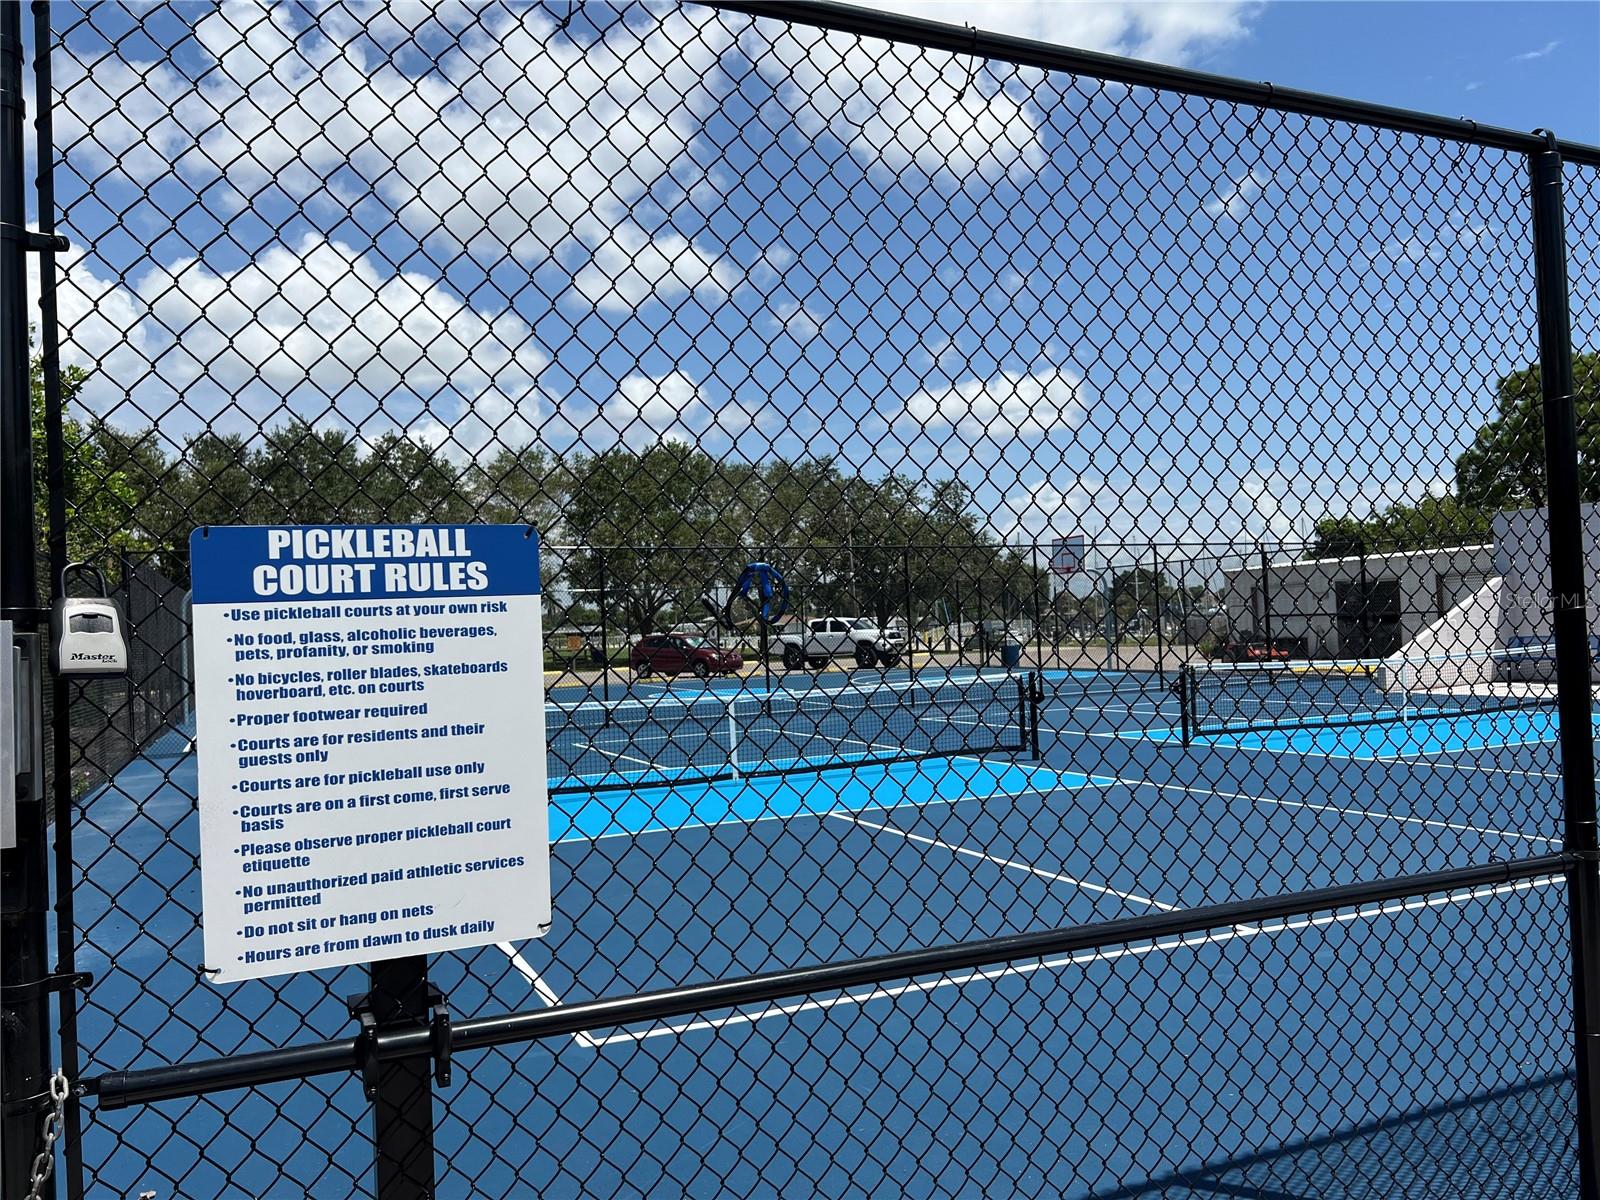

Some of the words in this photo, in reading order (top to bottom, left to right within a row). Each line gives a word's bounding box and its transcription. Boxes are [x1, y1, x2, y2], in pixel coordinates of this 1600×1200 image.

[268, 528, 471, 560] PICKLEBALL
[252, 562, 376, 596] COURT
[384, 561, 489, 592] RULES
[231, 608, 260, 621] Use
[263, 605, 340, 621] pickleball
[344, 605, 392, 617] courts
[395, 604, 410, 615] at
[412, 604, 445, 616] your
[448, 603, 477, 614] own
[480, 600, 507, 612] risk
[234, 633, 254, 646] No
[257, 631, 295, 645] food,
[299, 630, 344, 644] glass,
[346, 627, 416, 641] alcoholic
[419, 625, 497, 638] beverages,
[235, 648, 273, 662] pets,
[276, 644, 349, 660] profanity,
[352, 645, 368, 655] or
[371, 640, 434, 654] smoking
[235, 673, 254, 686] No
[257, 670, 324, 684] bicycles,
[326, 668, 367, 681] roller
[369, 665, 420, 678] blades,
[423, 660, 507, 676] skateboards
[236, 684, 325, 701] hoverboard,
[328, 684, 355, 695] etc.
[357, 683, 375, 694] on
[378, 680, 424, 693] courts
[236, 713, 289, 726] Proper
[292, 708, 360, 722] footwear
[364, 702, 427, 718] required
[237, 737, 290, 751] Courts
[293, 735, 319, 747] are
[322, 733, 344, 745] for
[347, 728, 418, 743] residents
[421, 724, 447, 738] and
[450, 722, 485, 735] their
[238, 752, 292, 768] guests
[295, 749, 328, 762] only
[239, 778, 291, 792] Courts
[294, 776, 320, 788] are
[323, 773, 345, 785] for
[348, 765, 422, 784] pickleball
[425, 765, 451, 777] use
[454, 761, 484, 774] only
[240, 803, 292, 818] Courts
[295, 800, 321, 812] are
[324, 798, 343, 810] on
[346, 797, 356, 808] a
[358, 793, 390, 807] first
[393, 790, 436, 804] come,
[439, 786, 469, 799] first
[471, 783, 510, 796] serve
[240, 817, 284, 832] basis
[240, 841, 291, 856] Please
[294, 835, 352, 851] observe
[355, 830, 403, 846] proper
[405, 821, 473, 840] pickleball
[476, 817, 511, 832] court
[242, 855, 310, 873] etiquette
[242, 885, 263, 898] No
[266, 872, 367, 895] unauthorized
[370, 868, 403, 884] paid
[406, 862, 462, 879] athletic
[464, 856, 524, 872] services
[243, 892, 321, 914] permitted
[244, 925, 264, 938] Do
[268, 921, 294, 935] not
[296, 918, 317, 931] sit
[320, 917, 336, 928] or
[339, 911, 376, 926] hang
[380, 909, 398, 920] on
[401, 904, 433, 918] nets
[245, 947, 291, 963] Hours
[294, 943, 320, 956] are
[323, 938, 359, 952] from
[362, 933, 402, 947] dawn
[405, 930, 419, 941] to
[422, 924, 457, 939] dusk
[460, 919, 494, 934] daily
